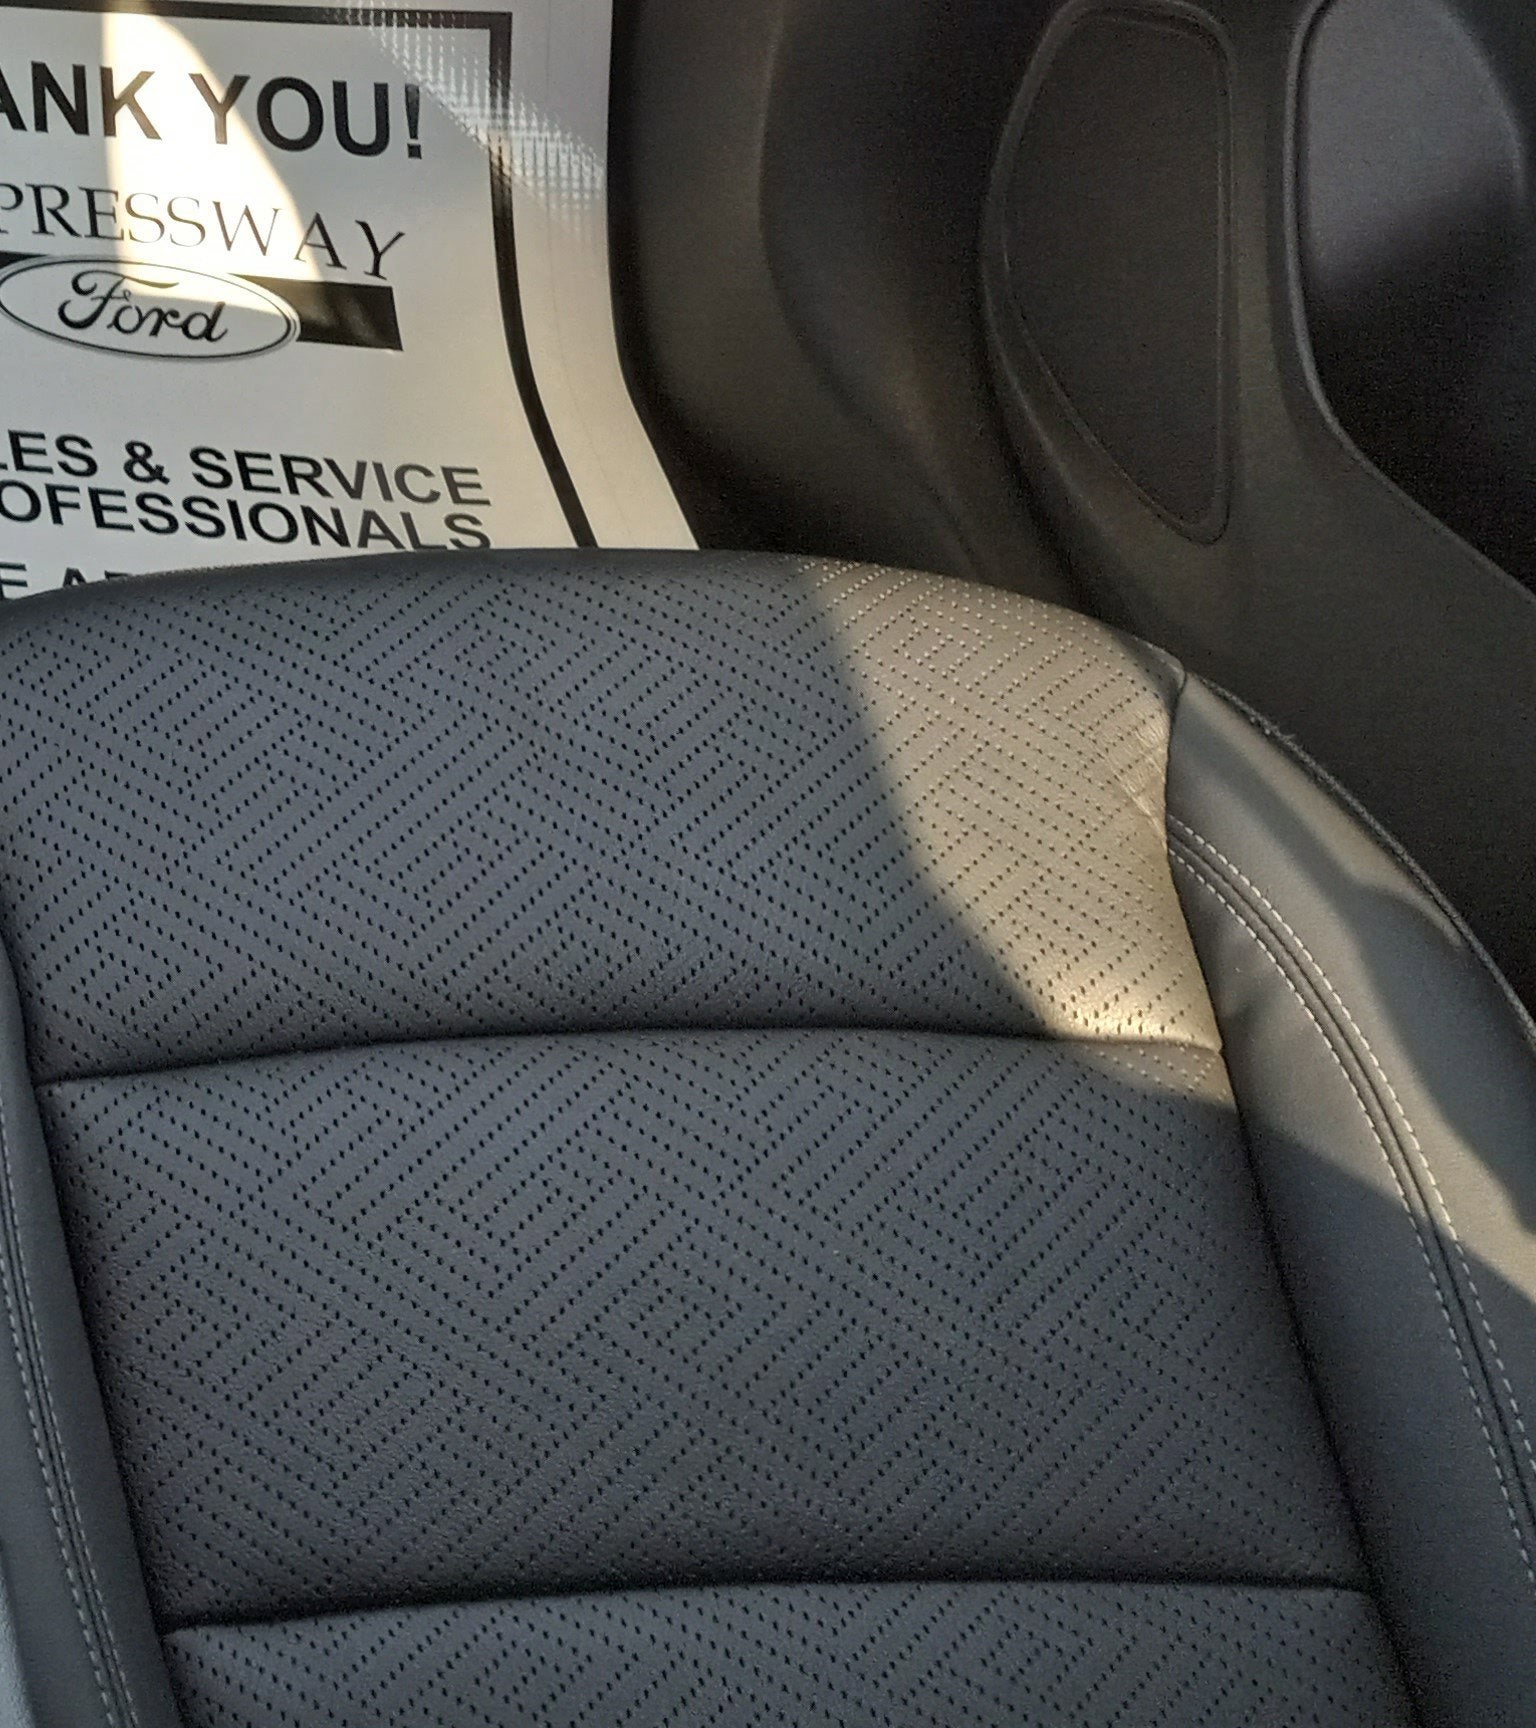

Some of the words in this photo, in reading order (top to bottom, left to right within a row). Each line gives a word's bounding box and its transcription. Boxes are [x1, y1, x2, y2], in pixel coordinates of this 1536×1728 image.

[188, 73, 423, 160] YOU!
[58, 269, 228, 345] Ford
[123, 440, 170, 484] &
[188, 446, 491, 508] SERVICE
